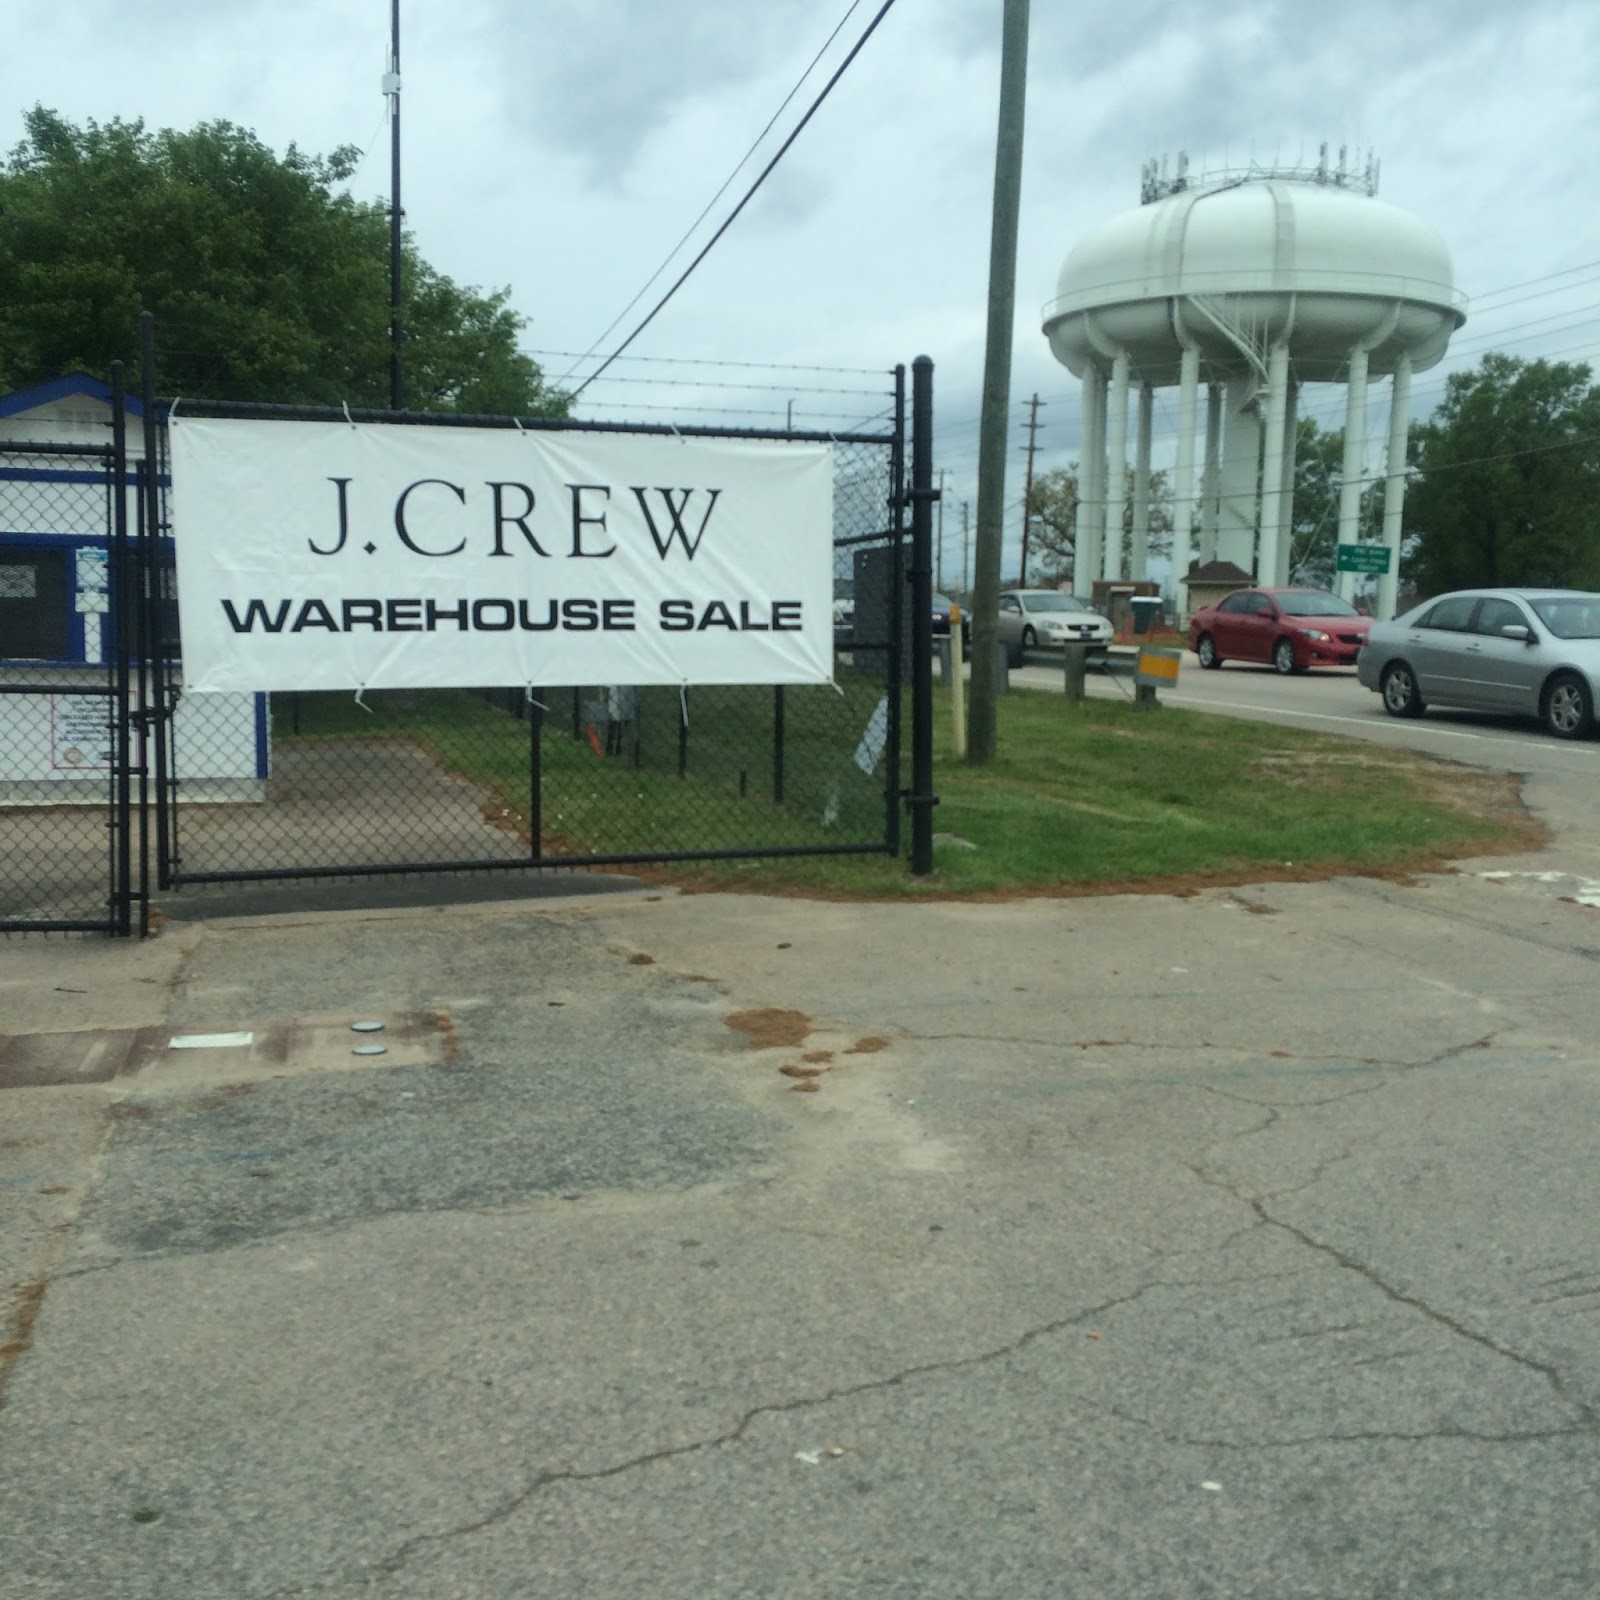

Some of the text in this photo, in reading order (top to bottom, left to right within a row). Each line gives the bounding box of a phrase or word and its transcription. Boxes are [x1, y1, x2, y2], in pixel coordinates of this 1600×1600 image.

[308, 477, 722, 561] J.CREW
[221, 598, 803, 633] WAREHOUSE SALE
